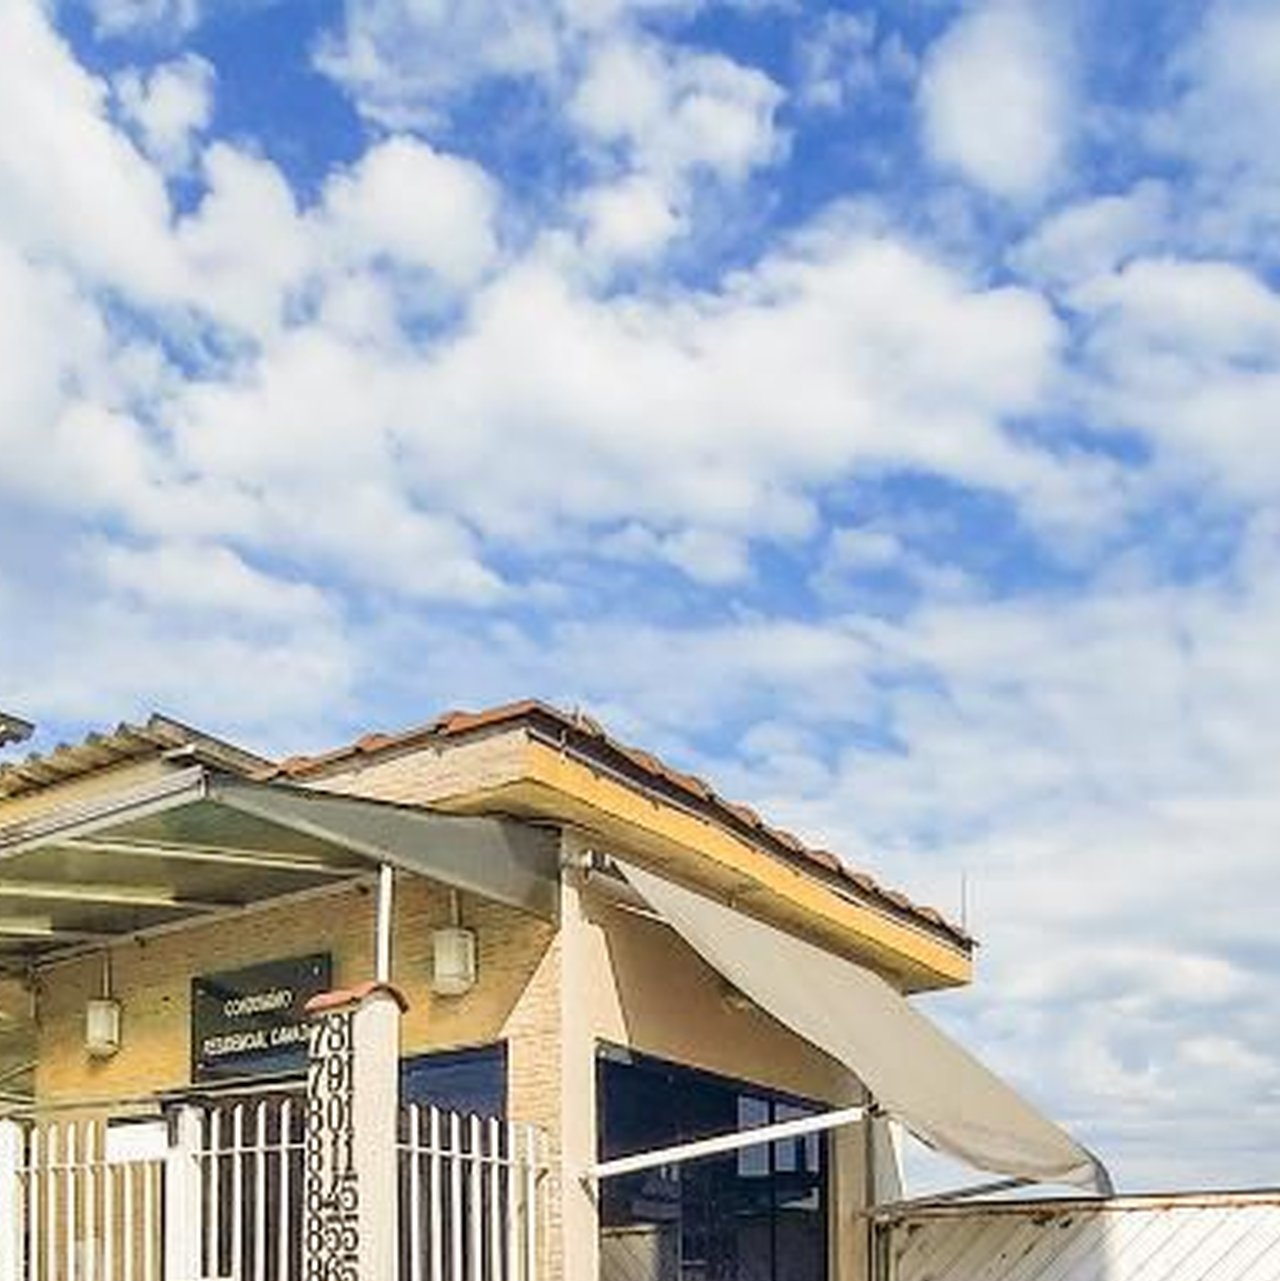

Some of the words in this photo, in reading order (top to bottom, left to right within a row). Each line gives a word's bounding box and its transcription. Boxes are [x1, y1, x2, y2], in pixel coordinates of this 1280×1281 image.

[308, 1012, 355, 1054] 781
[307, 1054, 355, 1095] 791
[307, 1094, 354, 1135] 801
[307, 1132, 354, 1172] 811
[307, 1172, 359, 1213] 845
[307, 1213, 359, 1254] 855
